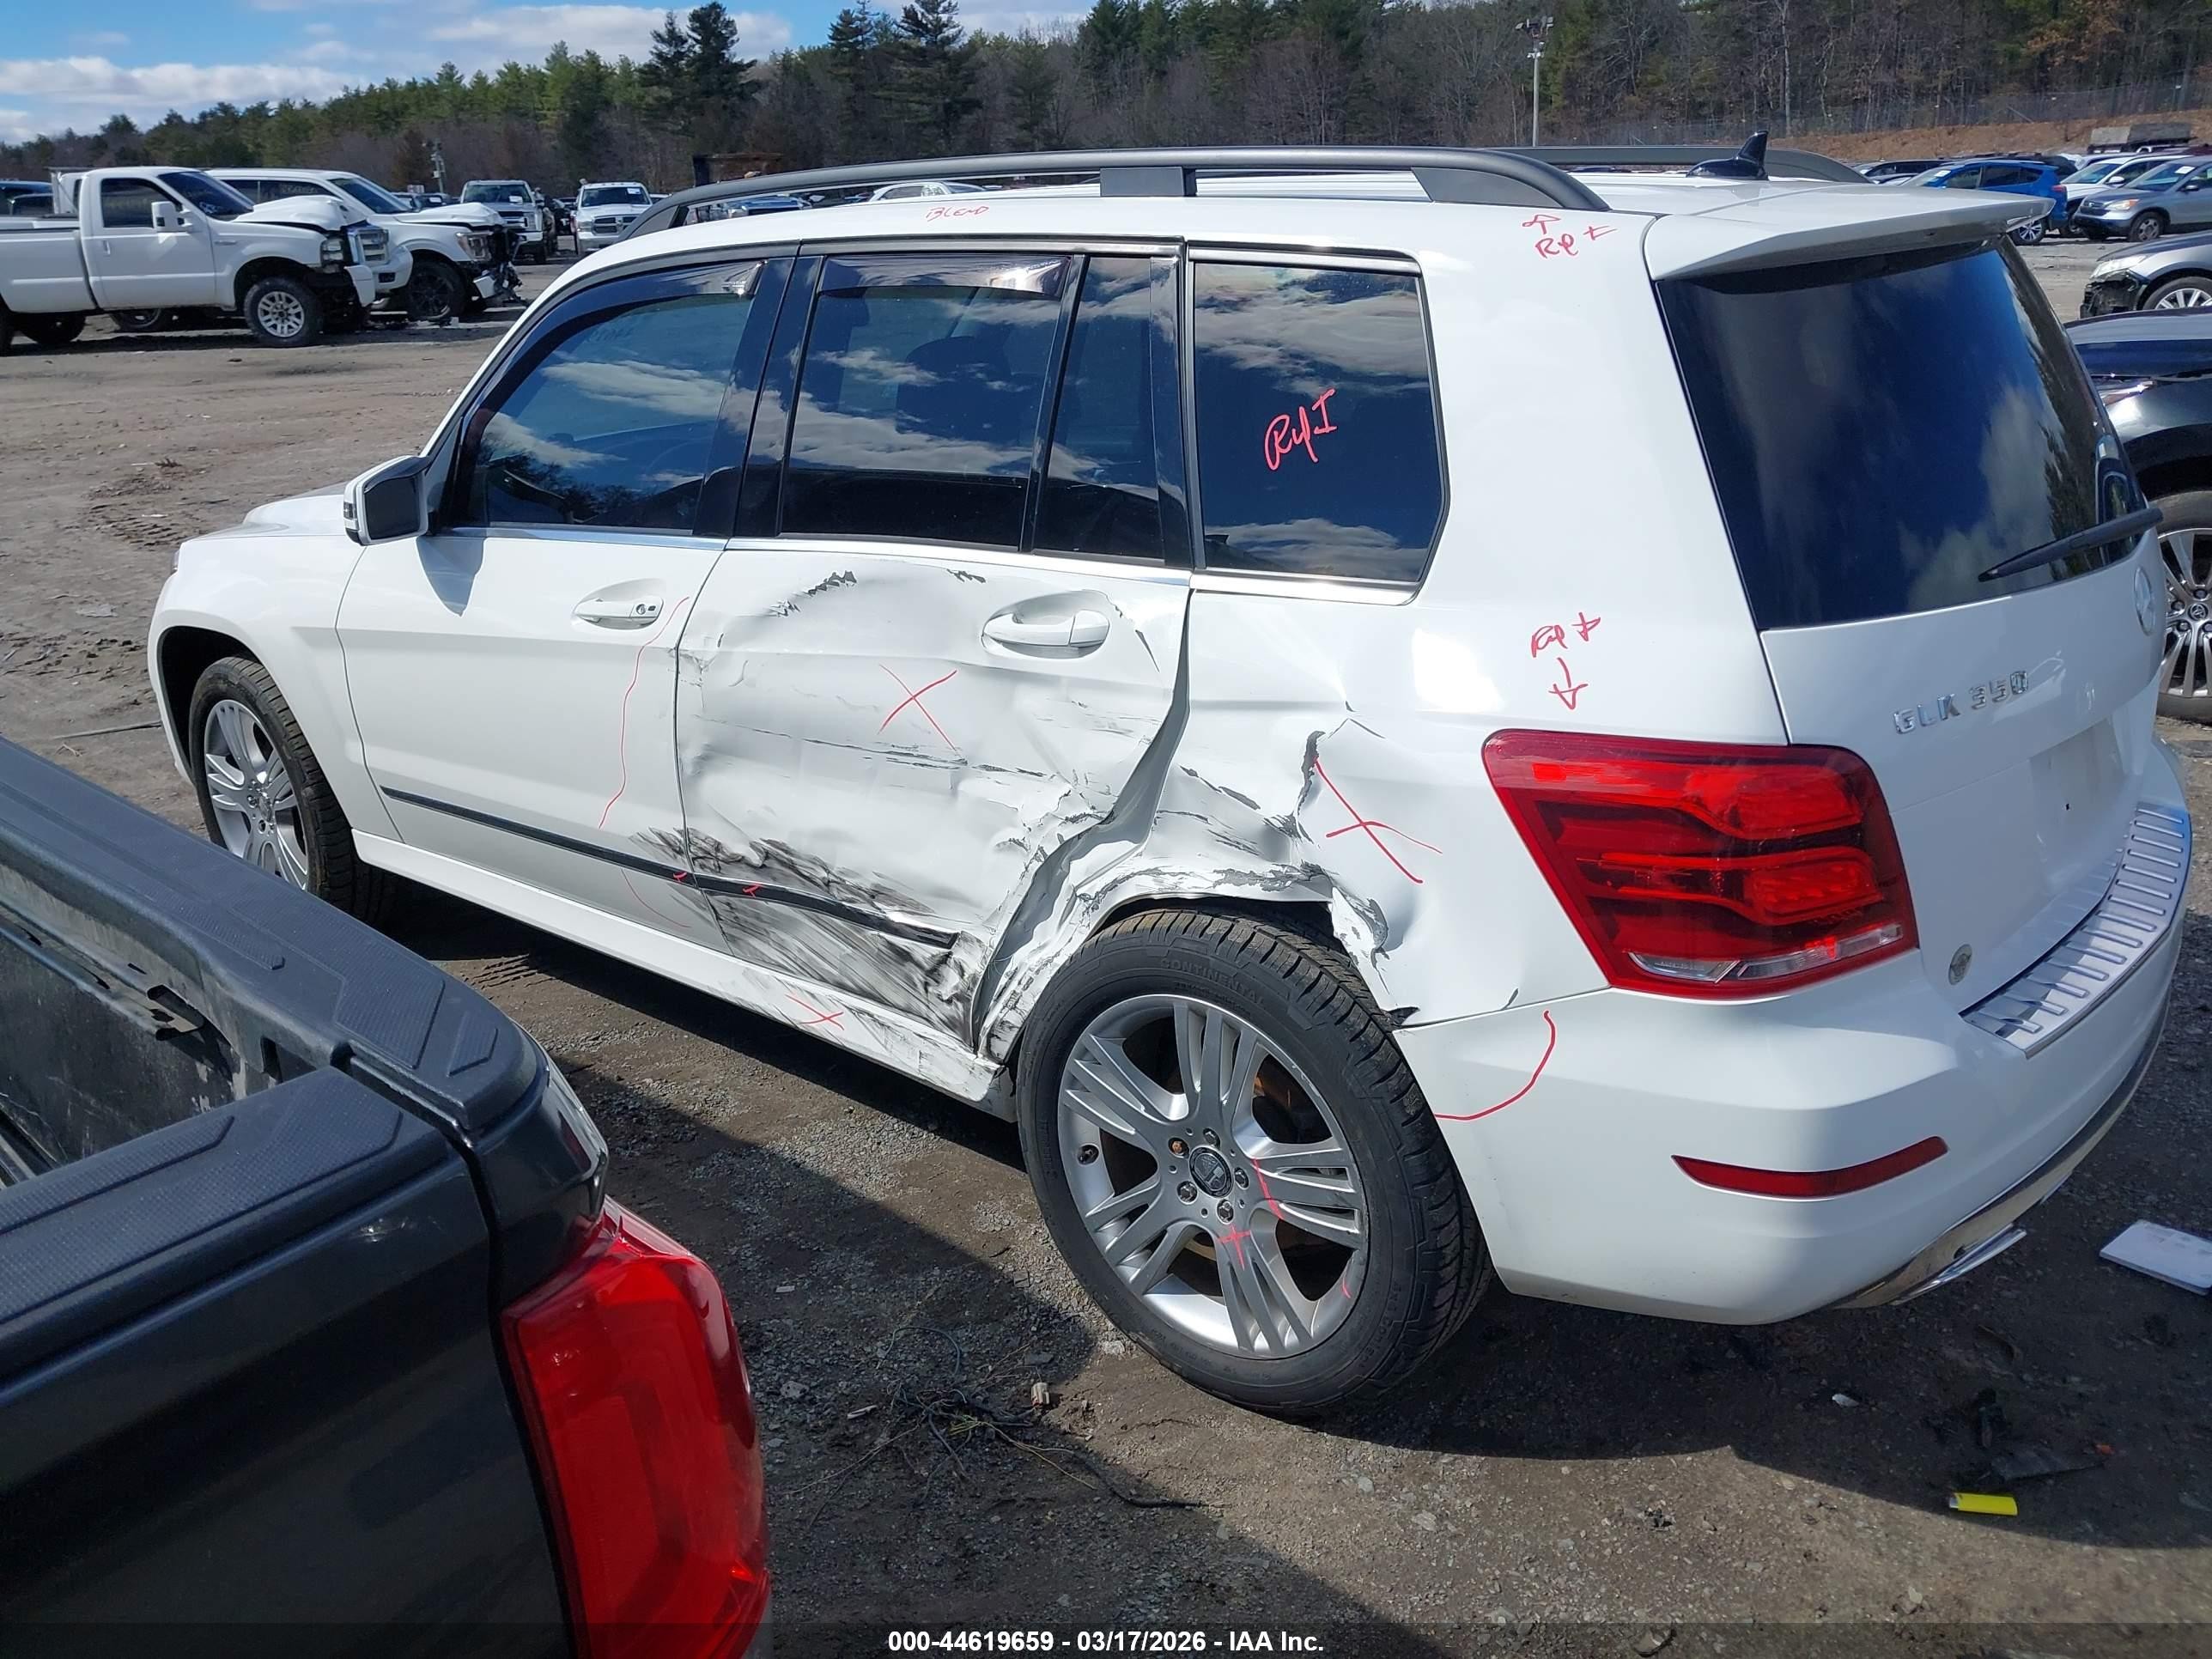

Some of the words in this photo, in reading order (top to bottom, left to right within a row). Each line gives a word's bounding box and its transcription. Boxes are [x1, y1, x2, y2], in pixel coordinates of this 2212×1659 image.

[1893, 693, 1961, 734] GLK
[1969, 670, 2029, 710] 350
[1159, 957, 1267, 1006] CONTINENTAL
